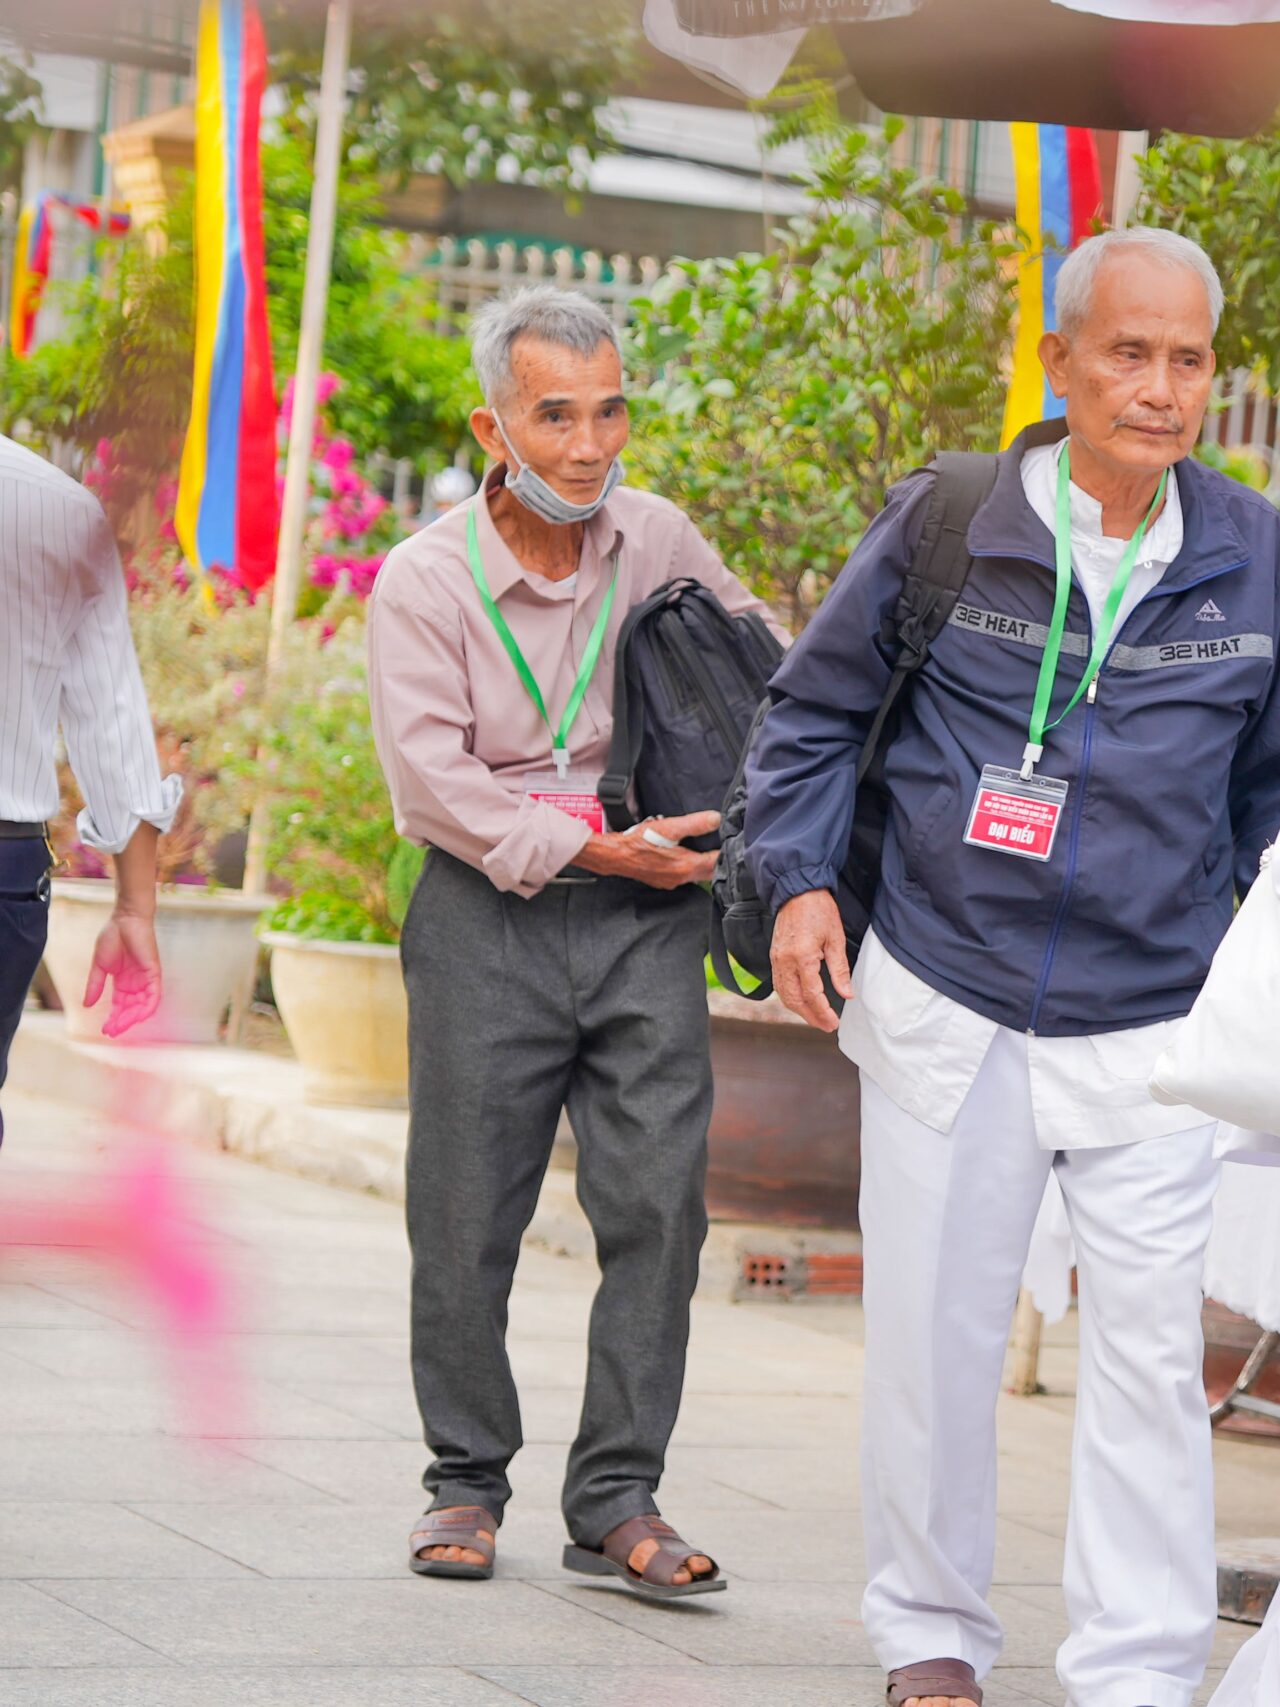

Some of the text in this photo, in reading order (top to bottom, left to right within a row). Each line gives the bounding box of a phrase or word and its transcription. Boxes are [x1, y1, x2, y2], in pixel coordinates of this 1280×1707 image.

[956, 606, 1030, 638] 32 HEAT
[1160, 638, 1240, 661] 32 HEAT
[1009, 824, 1036, 844] BIỂU
